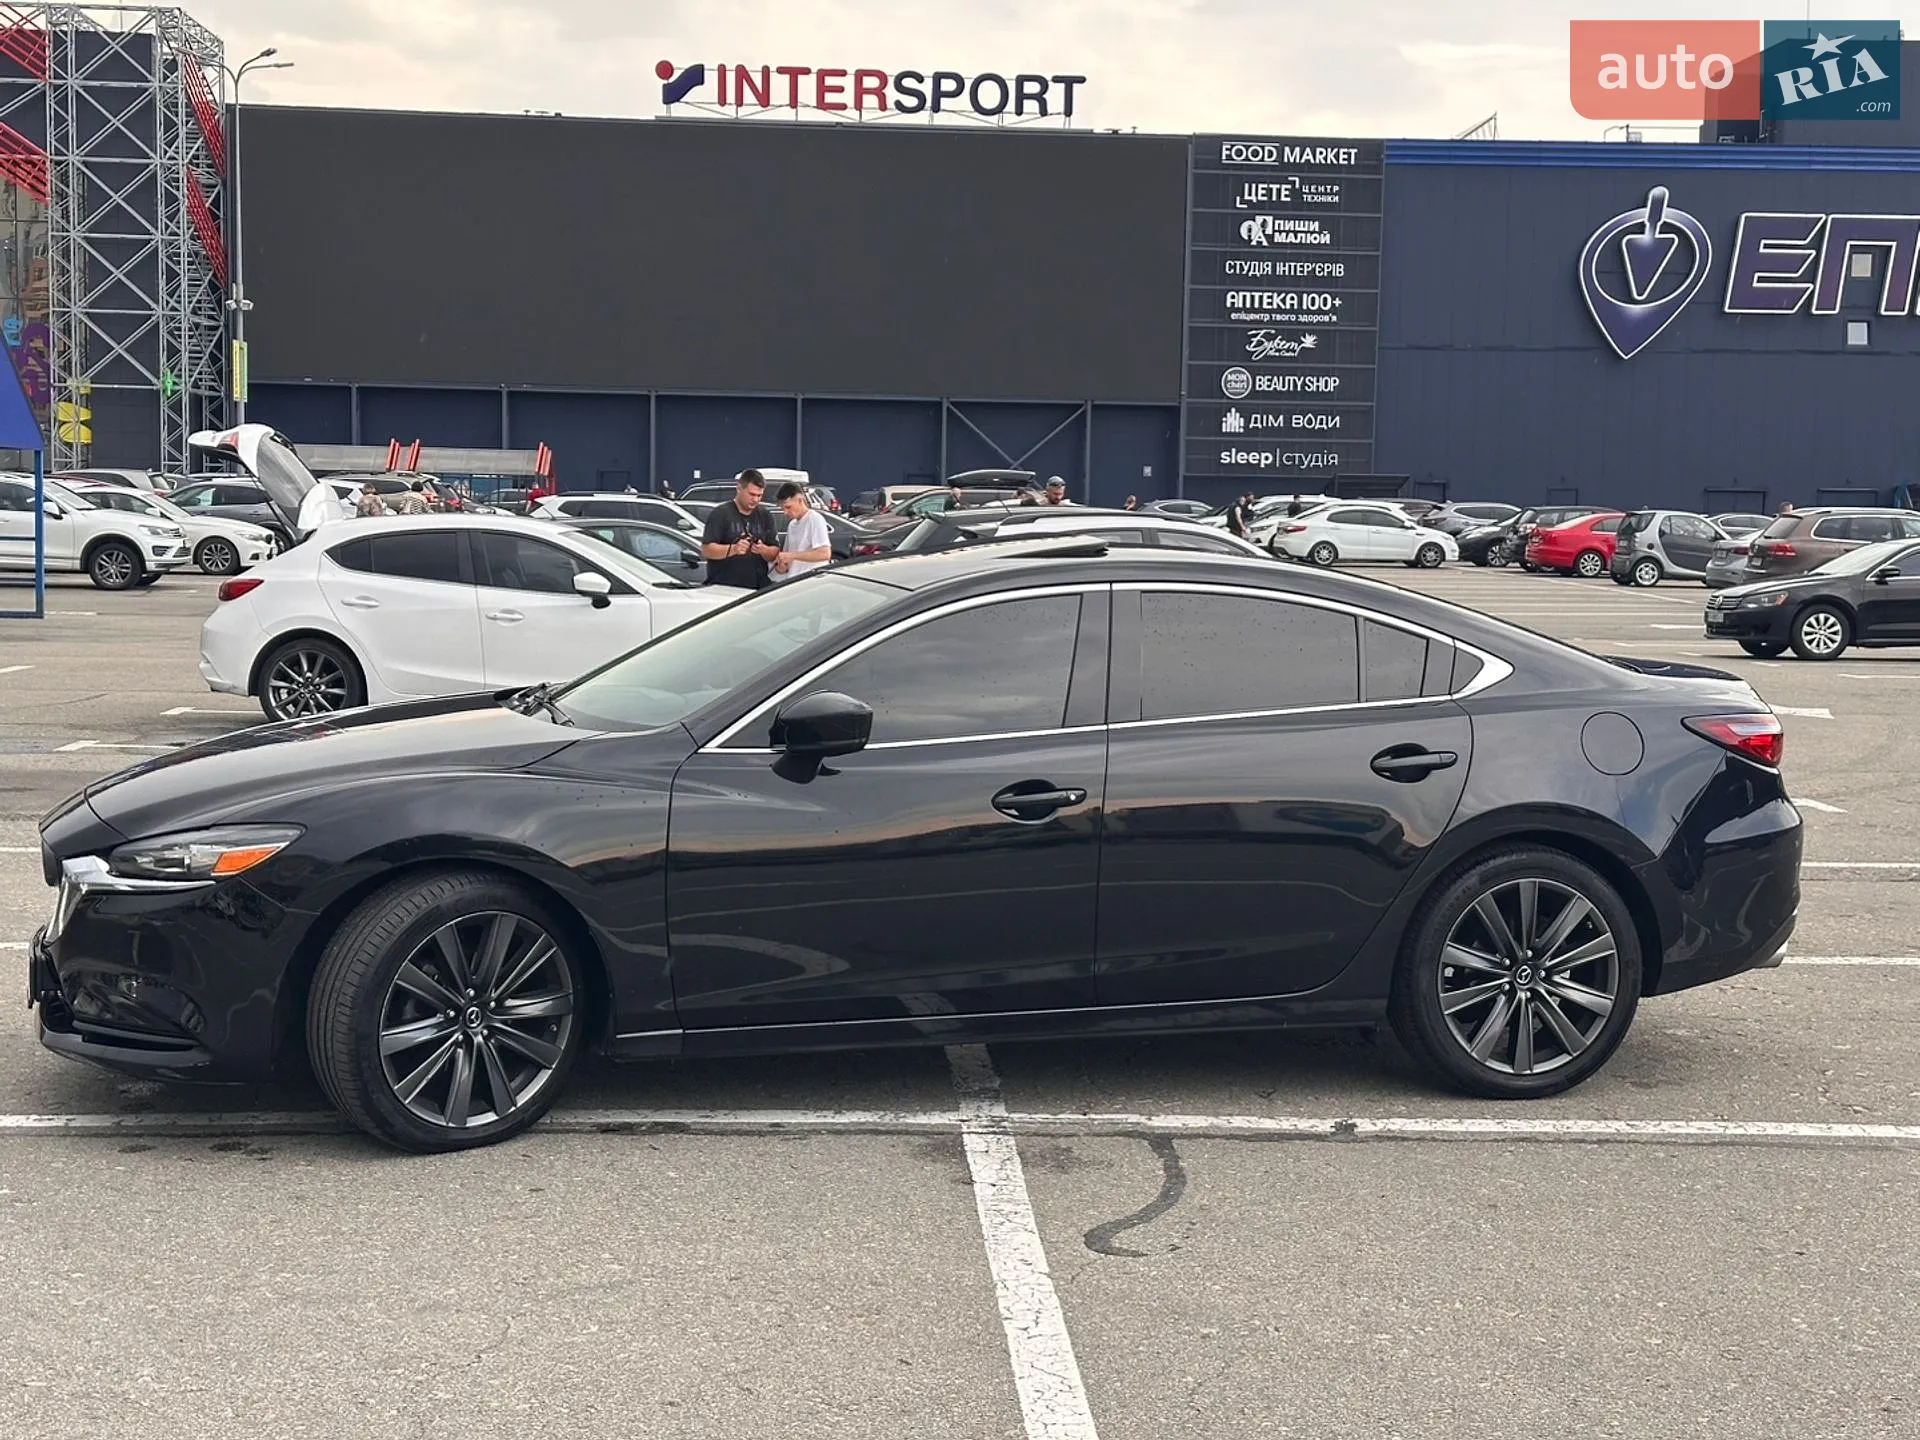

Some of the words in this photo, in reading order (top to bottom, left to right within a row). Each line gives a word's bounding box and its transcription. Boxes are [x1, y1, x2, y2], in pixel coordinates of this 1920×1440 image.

[717, 63, 1087, 117] INTERSPORT
[1221, 144, 1278, 162] FOOD
[1283, 146, 1358, 165] MARKET
[1243, 182, 1292, 203] ЦЕТЕ
[1302, 184, 1340, 194] ЦЕНТР
[1274, 220, 1320, 232] ПИШИ
[1273, 230, 1331, 245] МАЛЮЙ
[1225, 260, 1272, 277] СТУДІЯ
[1724, 212, 1920, 315] ЕП
[1226, 291, 1298, 309] АПТЕКА
[1302, 293, 1343, 310] 100+
[1245, 329, 1302, 361] Букет
[1255, 375, 1305, 391] BEAUTY
[1305, 376, 1340, 392] SHOP
[1249, 413, 1284, 429] ДІМ
[1291, 413, 1341, 430] ВОДИ
[1220, 448, 1273, 468] sleep
[1282, 450, 1339, 469] студія
